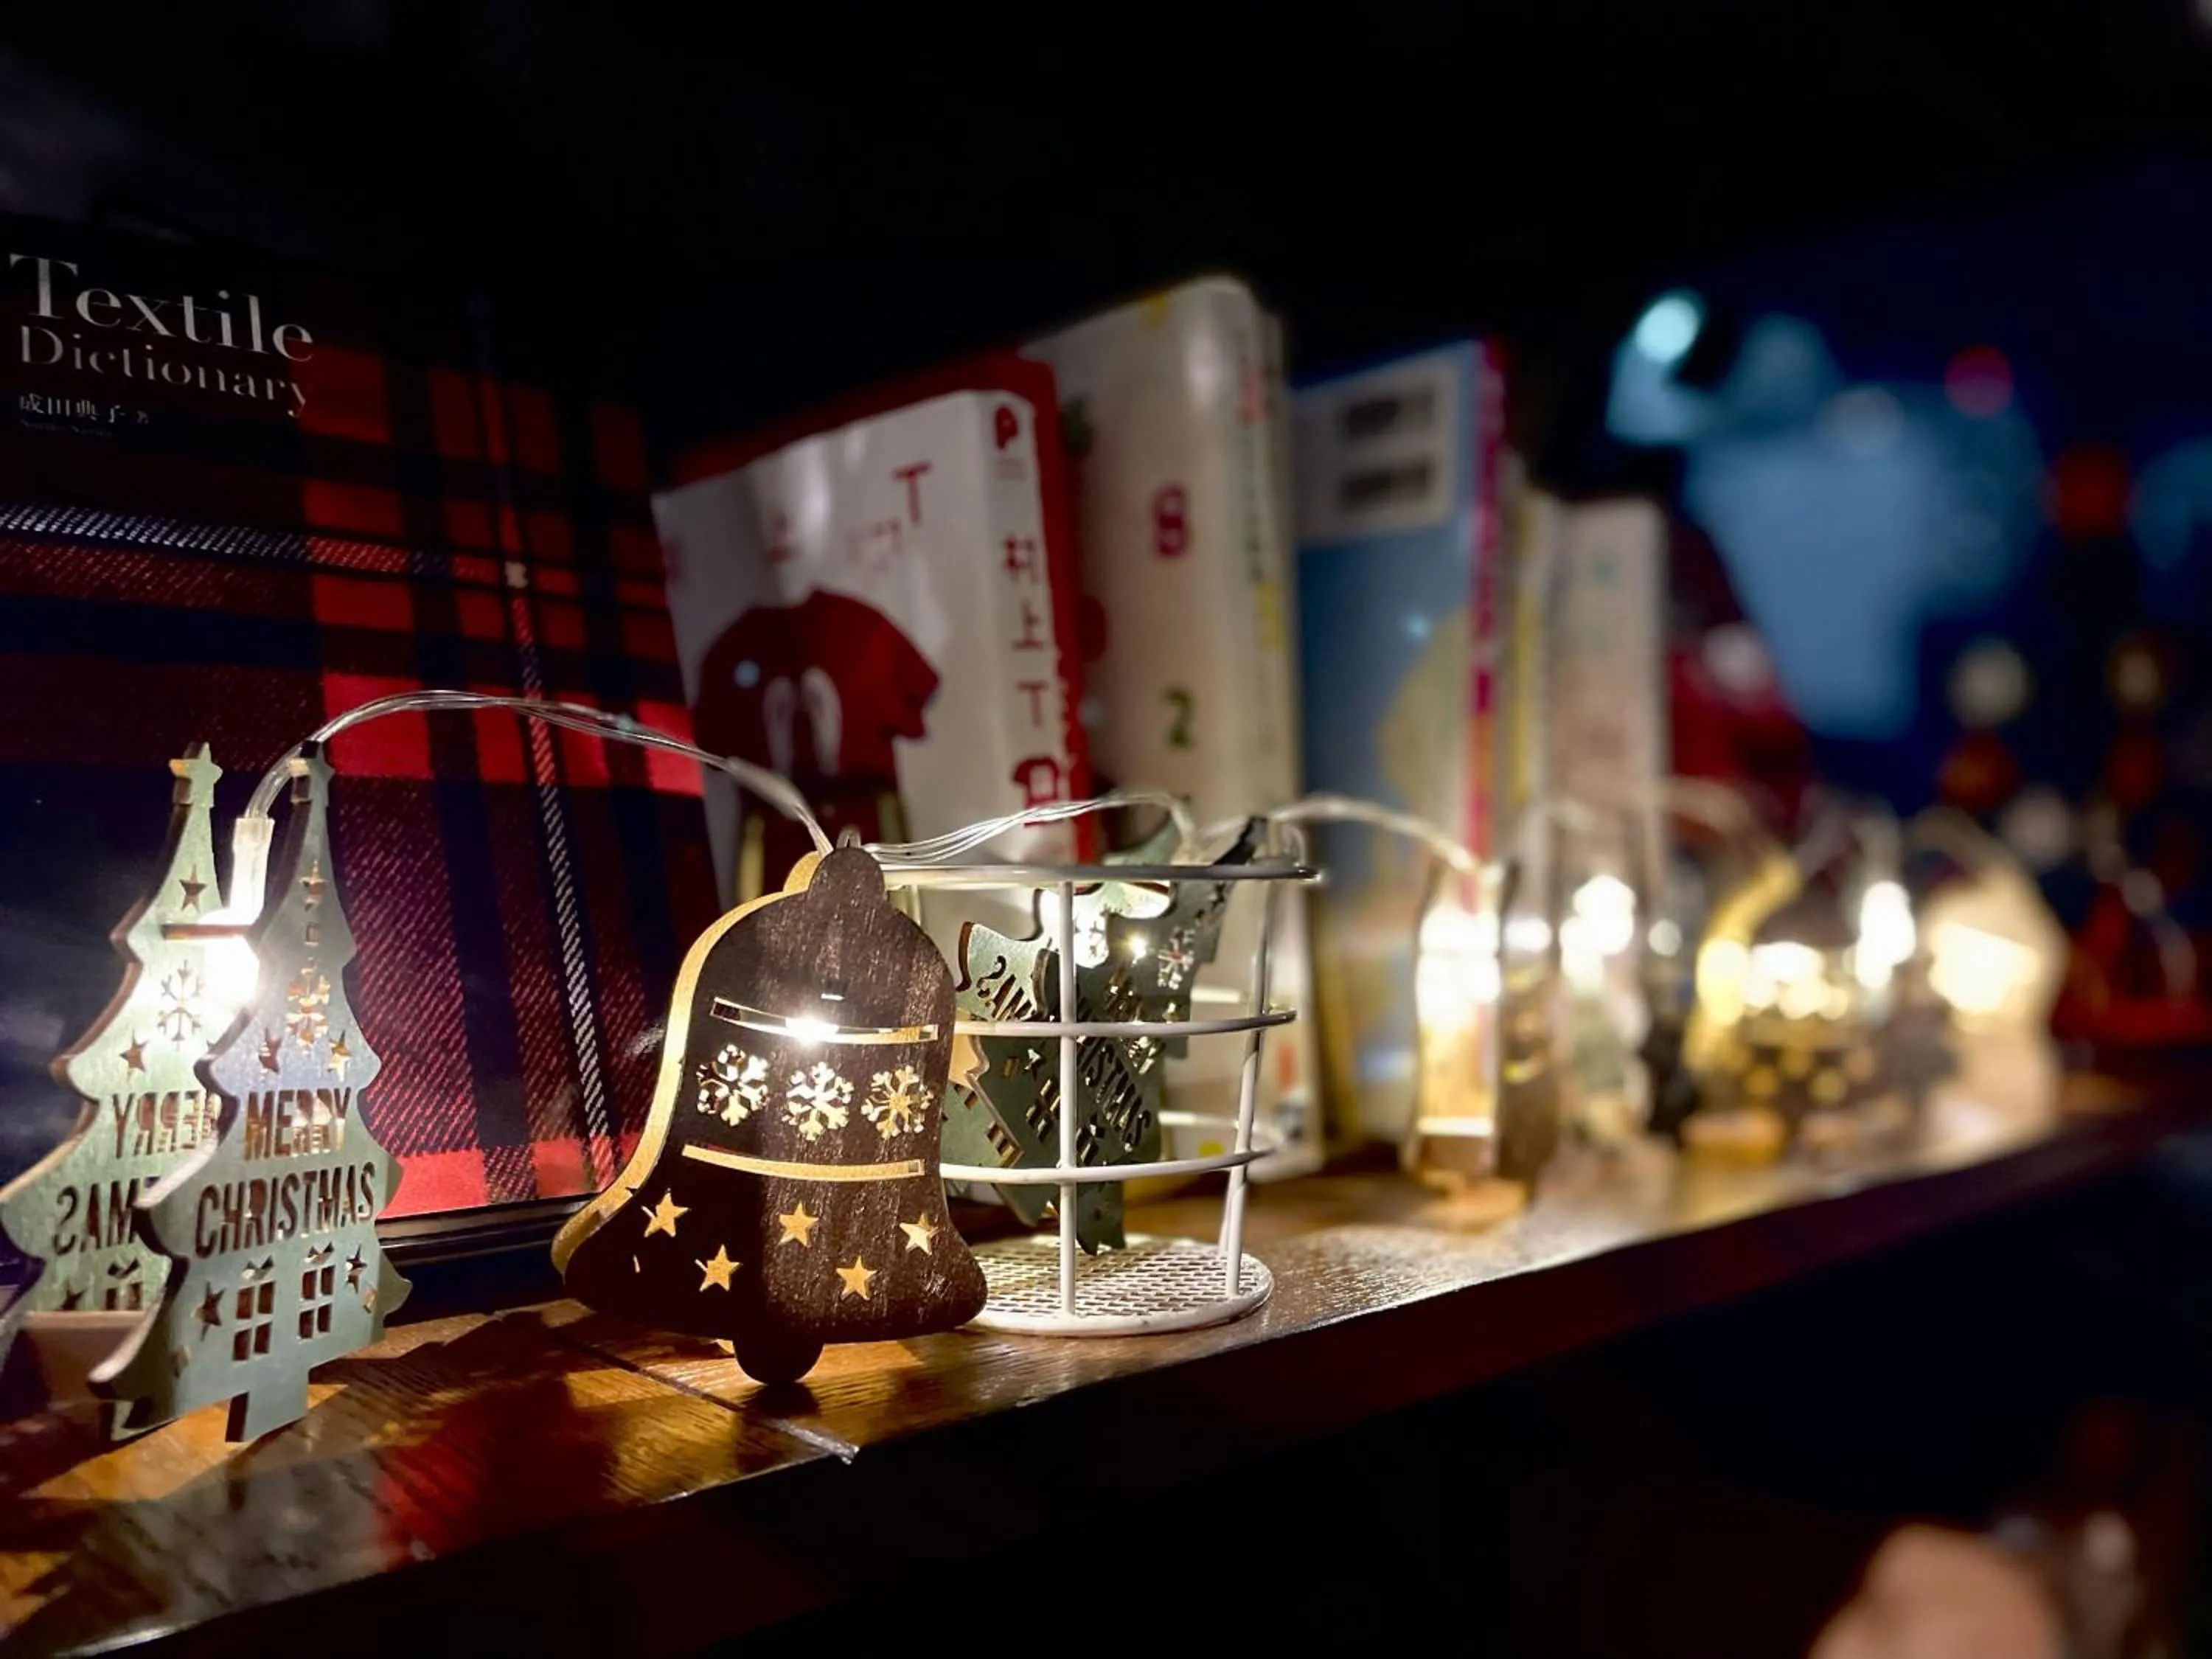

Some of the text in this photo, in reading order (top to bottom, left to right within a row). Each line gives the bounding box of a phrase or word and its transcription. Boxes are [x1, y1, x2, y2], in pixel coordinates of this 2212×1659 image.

[9, 253, 314, 362] Textile
[20, 324, 307, 418] Dictionary
[244, 1087, 352, 1161] MERRY
[195, 1161, 375, 1259] CHRISTMAS
